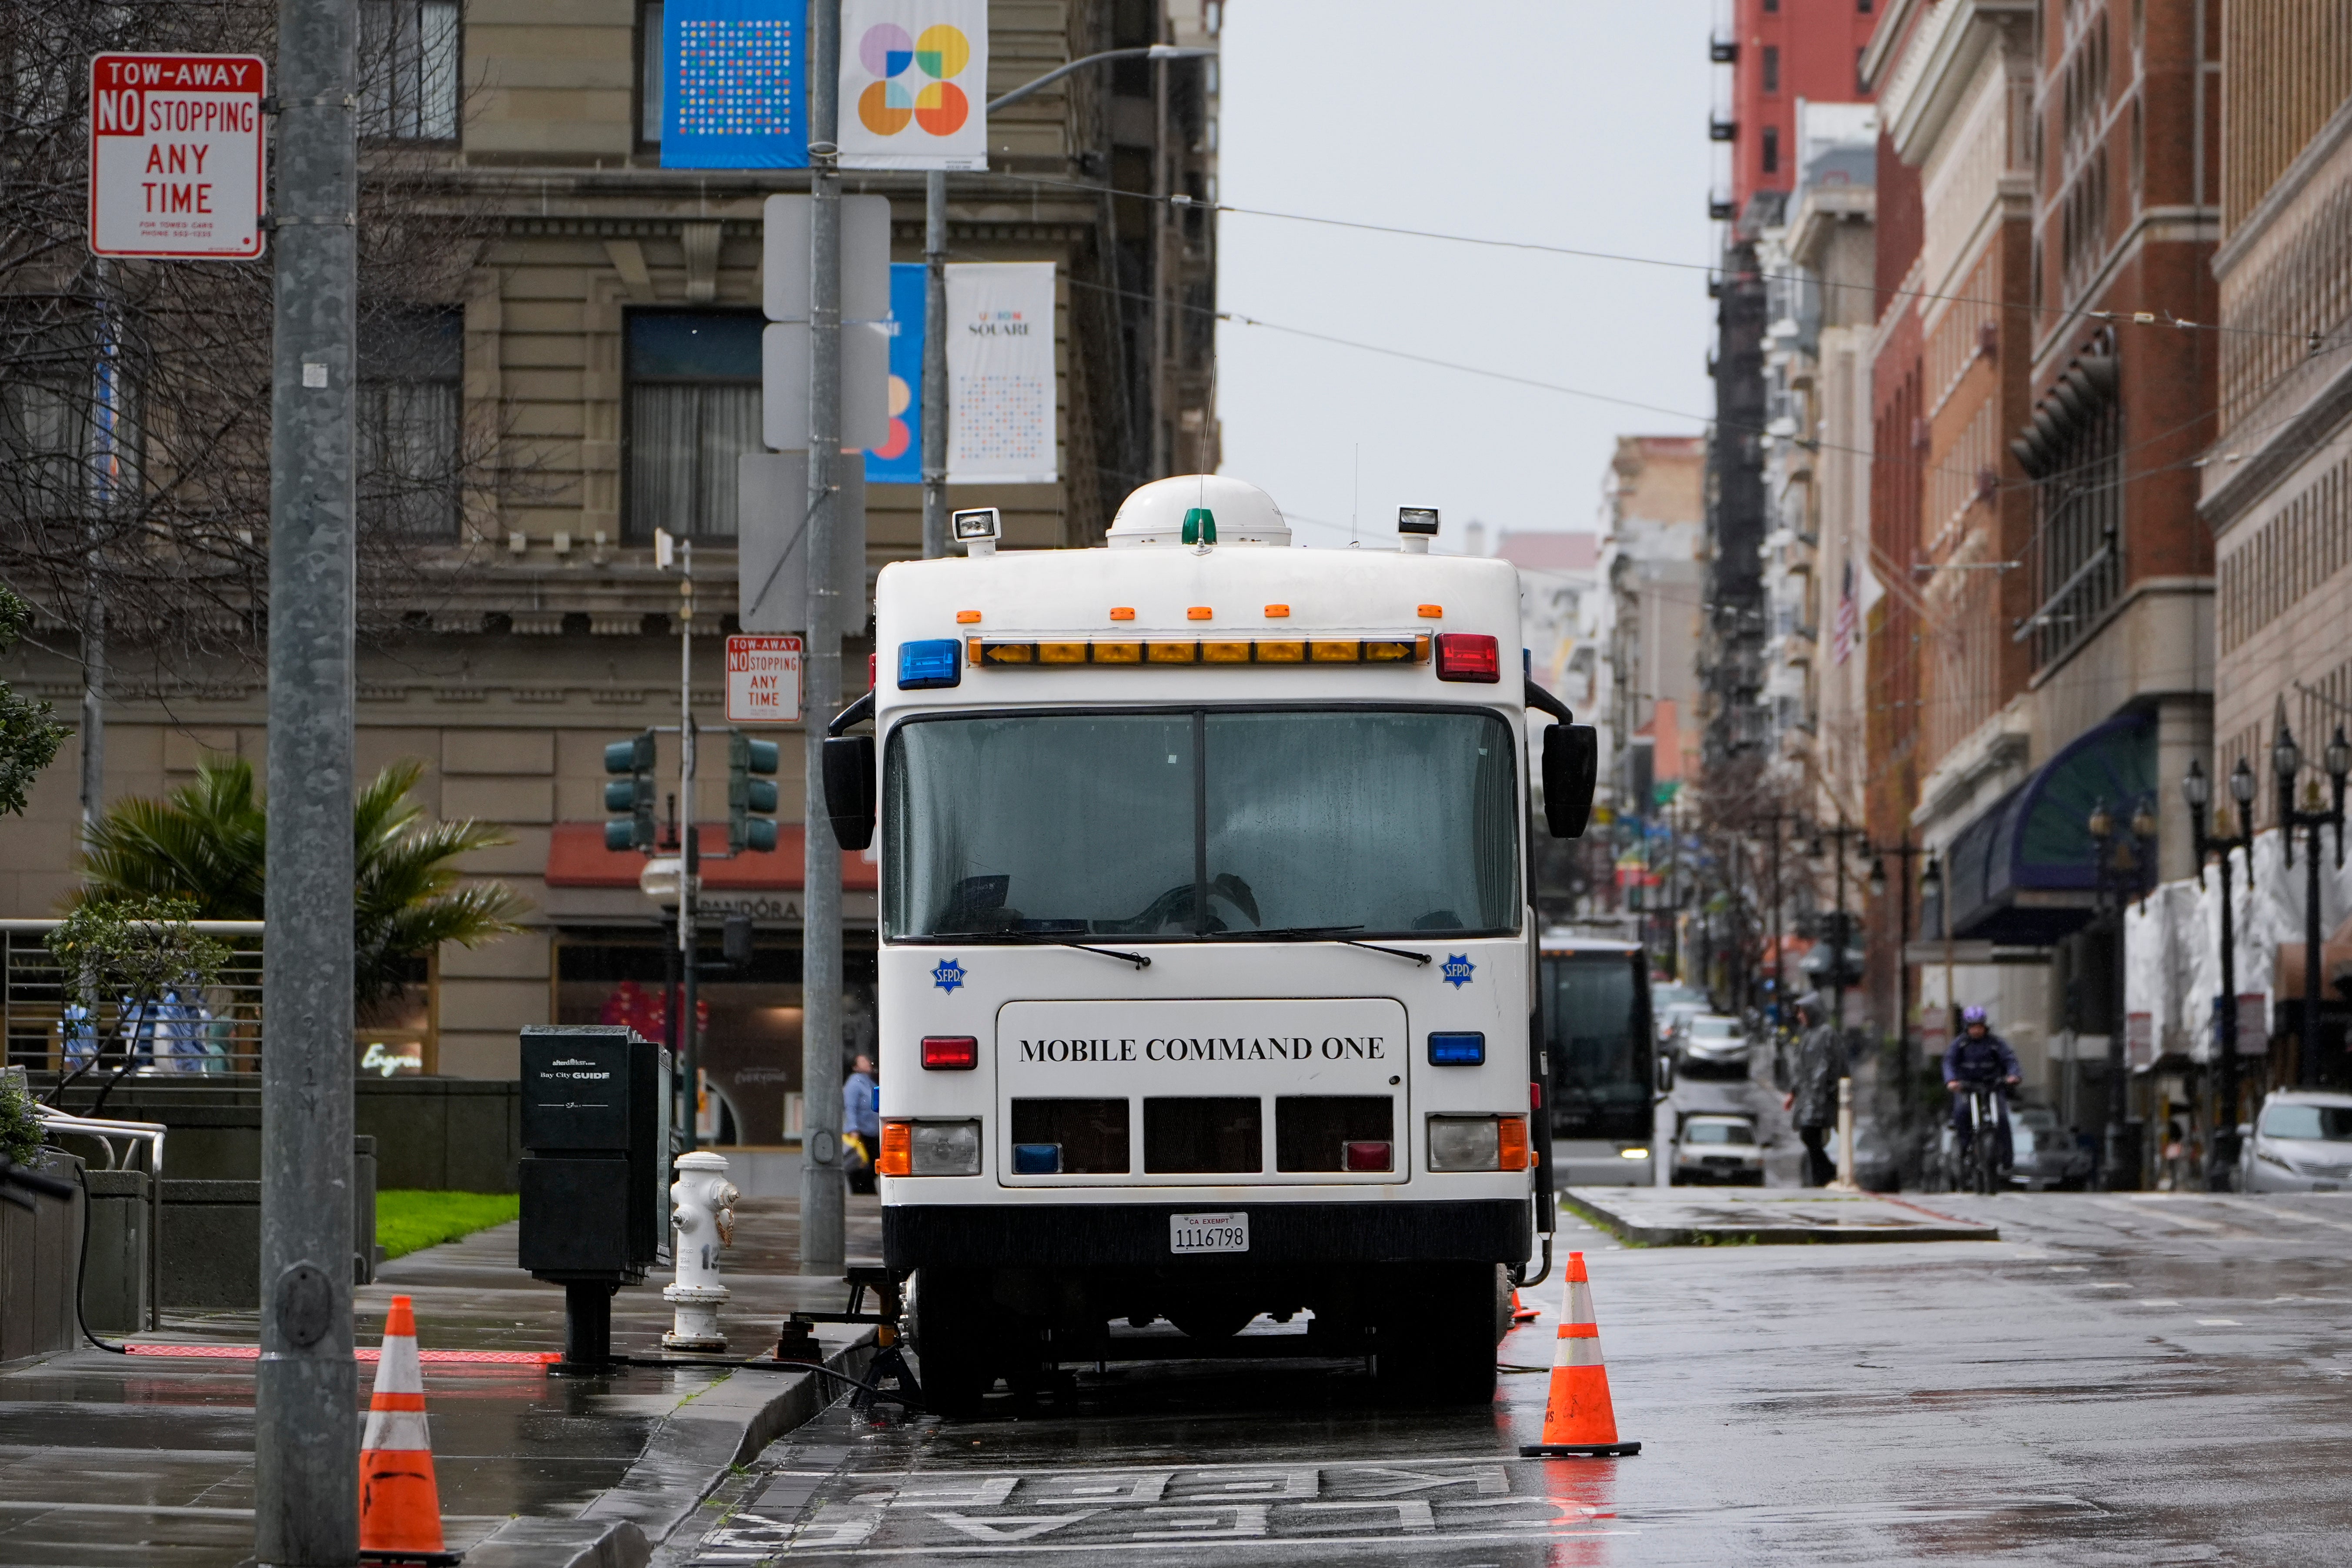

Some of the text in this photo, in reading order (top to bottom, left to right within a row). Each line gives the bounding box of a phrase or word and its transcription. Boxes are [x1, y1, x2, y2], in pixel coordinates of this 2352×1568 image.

[108, 63, 249, 87] TOW-AWAY
[98, 89, 253, 133] NO STOPPING
[146, 144, 209, 174] ANY
[141, 183, 212, 214] TIME
[979, 310, 1022, 321] UION
[732, 639, 795, 649] TOW-AWAY
[730, 652, 797, 671] NO STOPPING
[751, 675, 778, 689] ANY
[748, 692, 779, 706] TIME
[1019, 1037, 1384, 1062] MOBILE COMMAND ONE
[1176, 1227, 1243, 1247] 1116798
